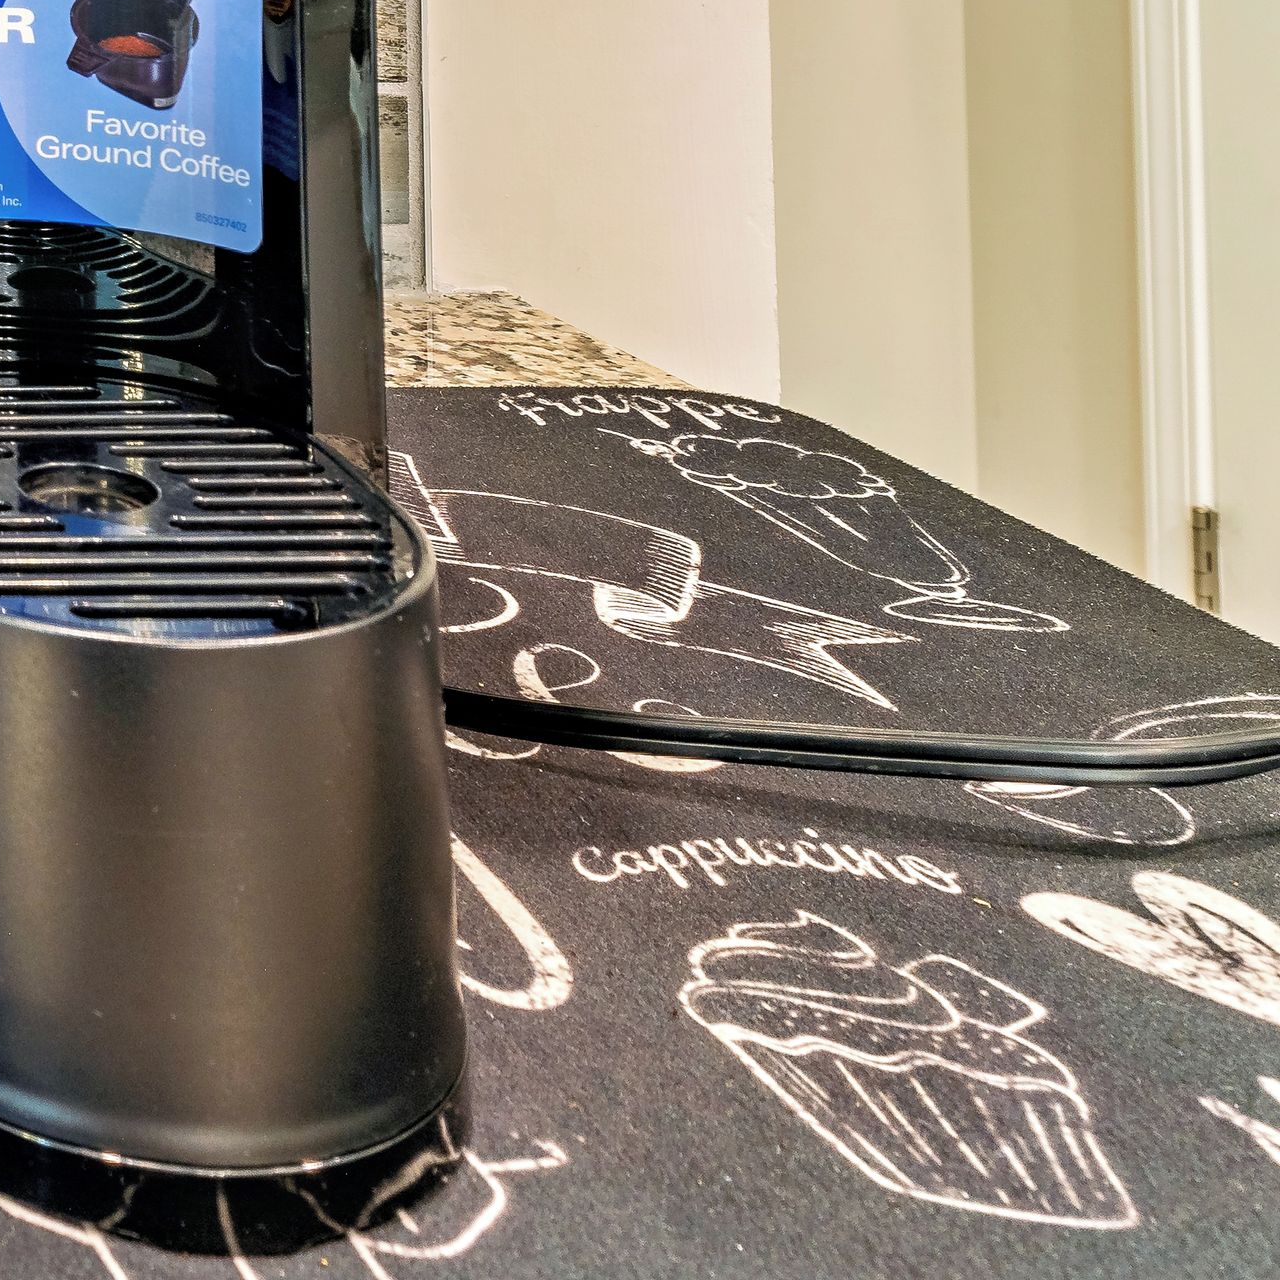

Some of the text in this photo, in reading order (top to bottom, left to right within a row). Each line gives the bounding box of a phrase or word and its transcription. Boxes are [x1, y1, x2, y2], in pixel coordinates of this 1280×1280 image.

[86, 110, 207, 147] Favorite
[36, 135, 251, 187] Ground Coffee
[2, 195, 23, 207] Inc.
[498, 392, 781, 430] Frappe
